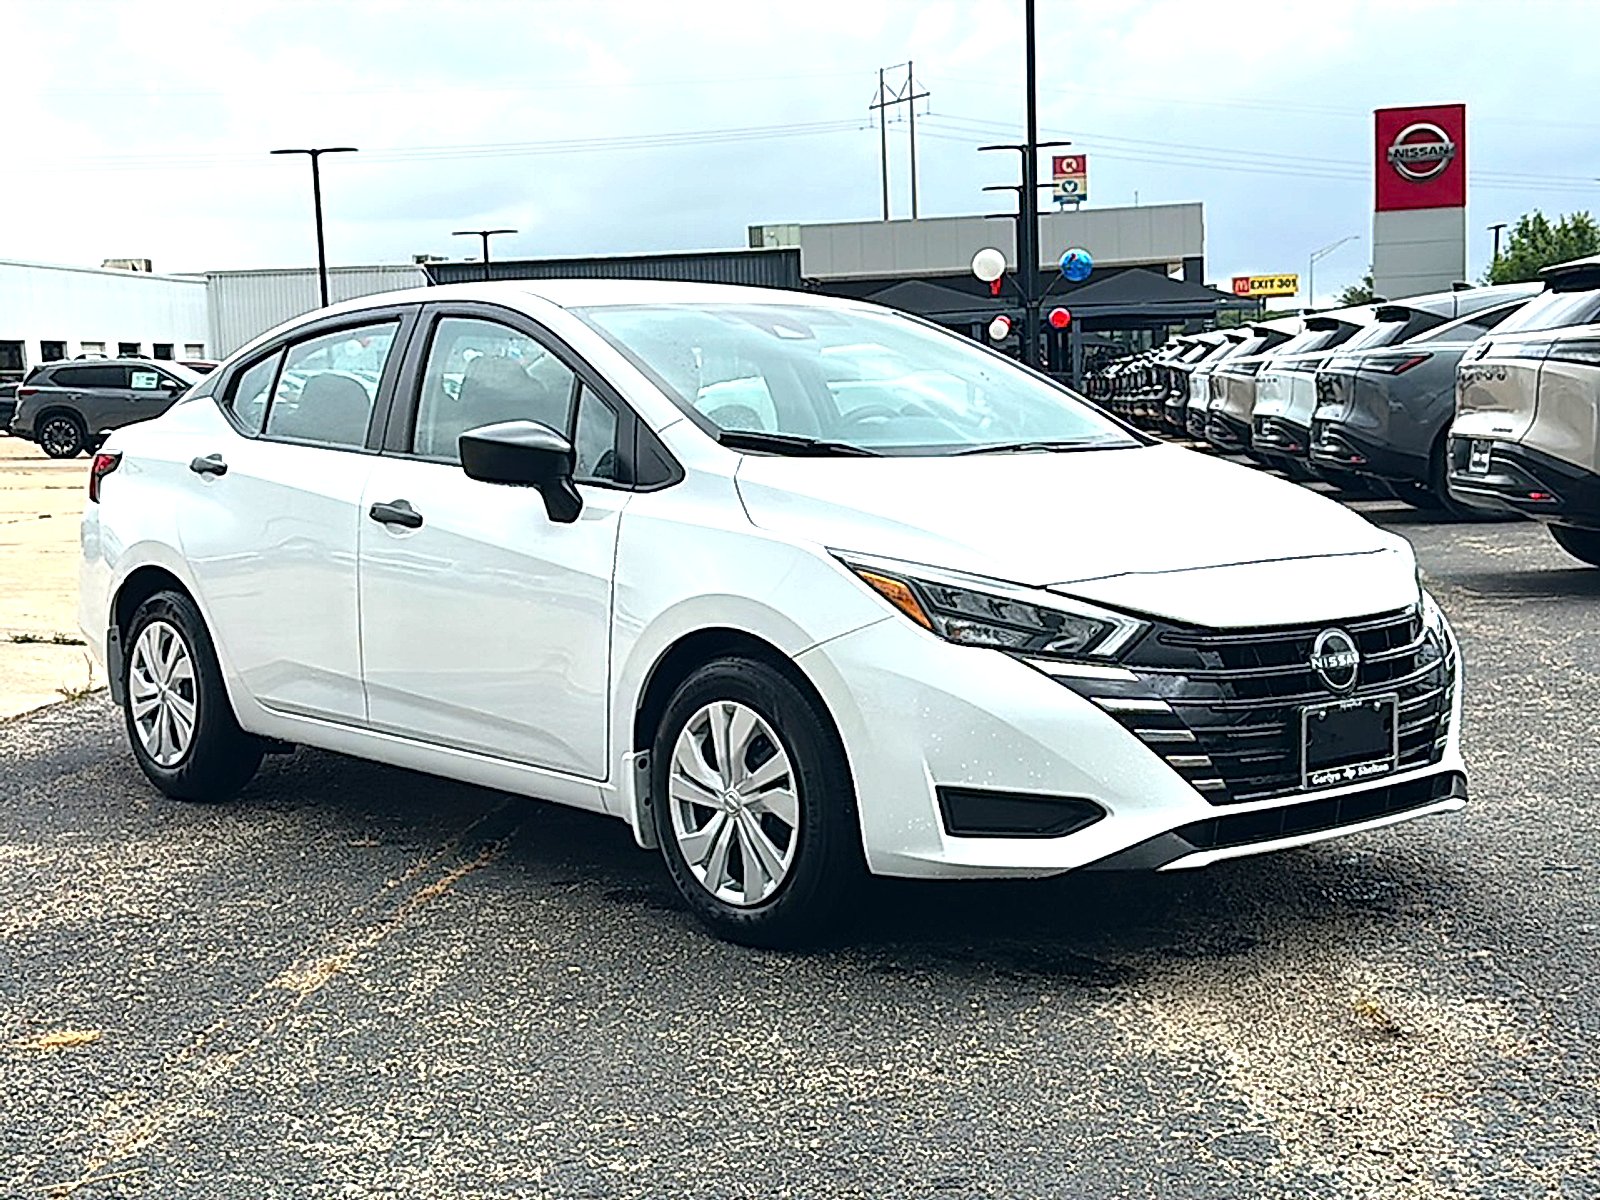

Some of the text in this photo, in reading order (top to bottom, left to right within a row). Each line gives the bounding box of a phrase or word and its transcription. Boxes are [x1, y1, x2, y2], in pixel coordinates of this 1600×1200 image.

[1393, 145, 1449, 158] NISSAN
[1250, 278, 1296, 289] EXIT 301
[1311, 653, 1359, 669] NISSAN
